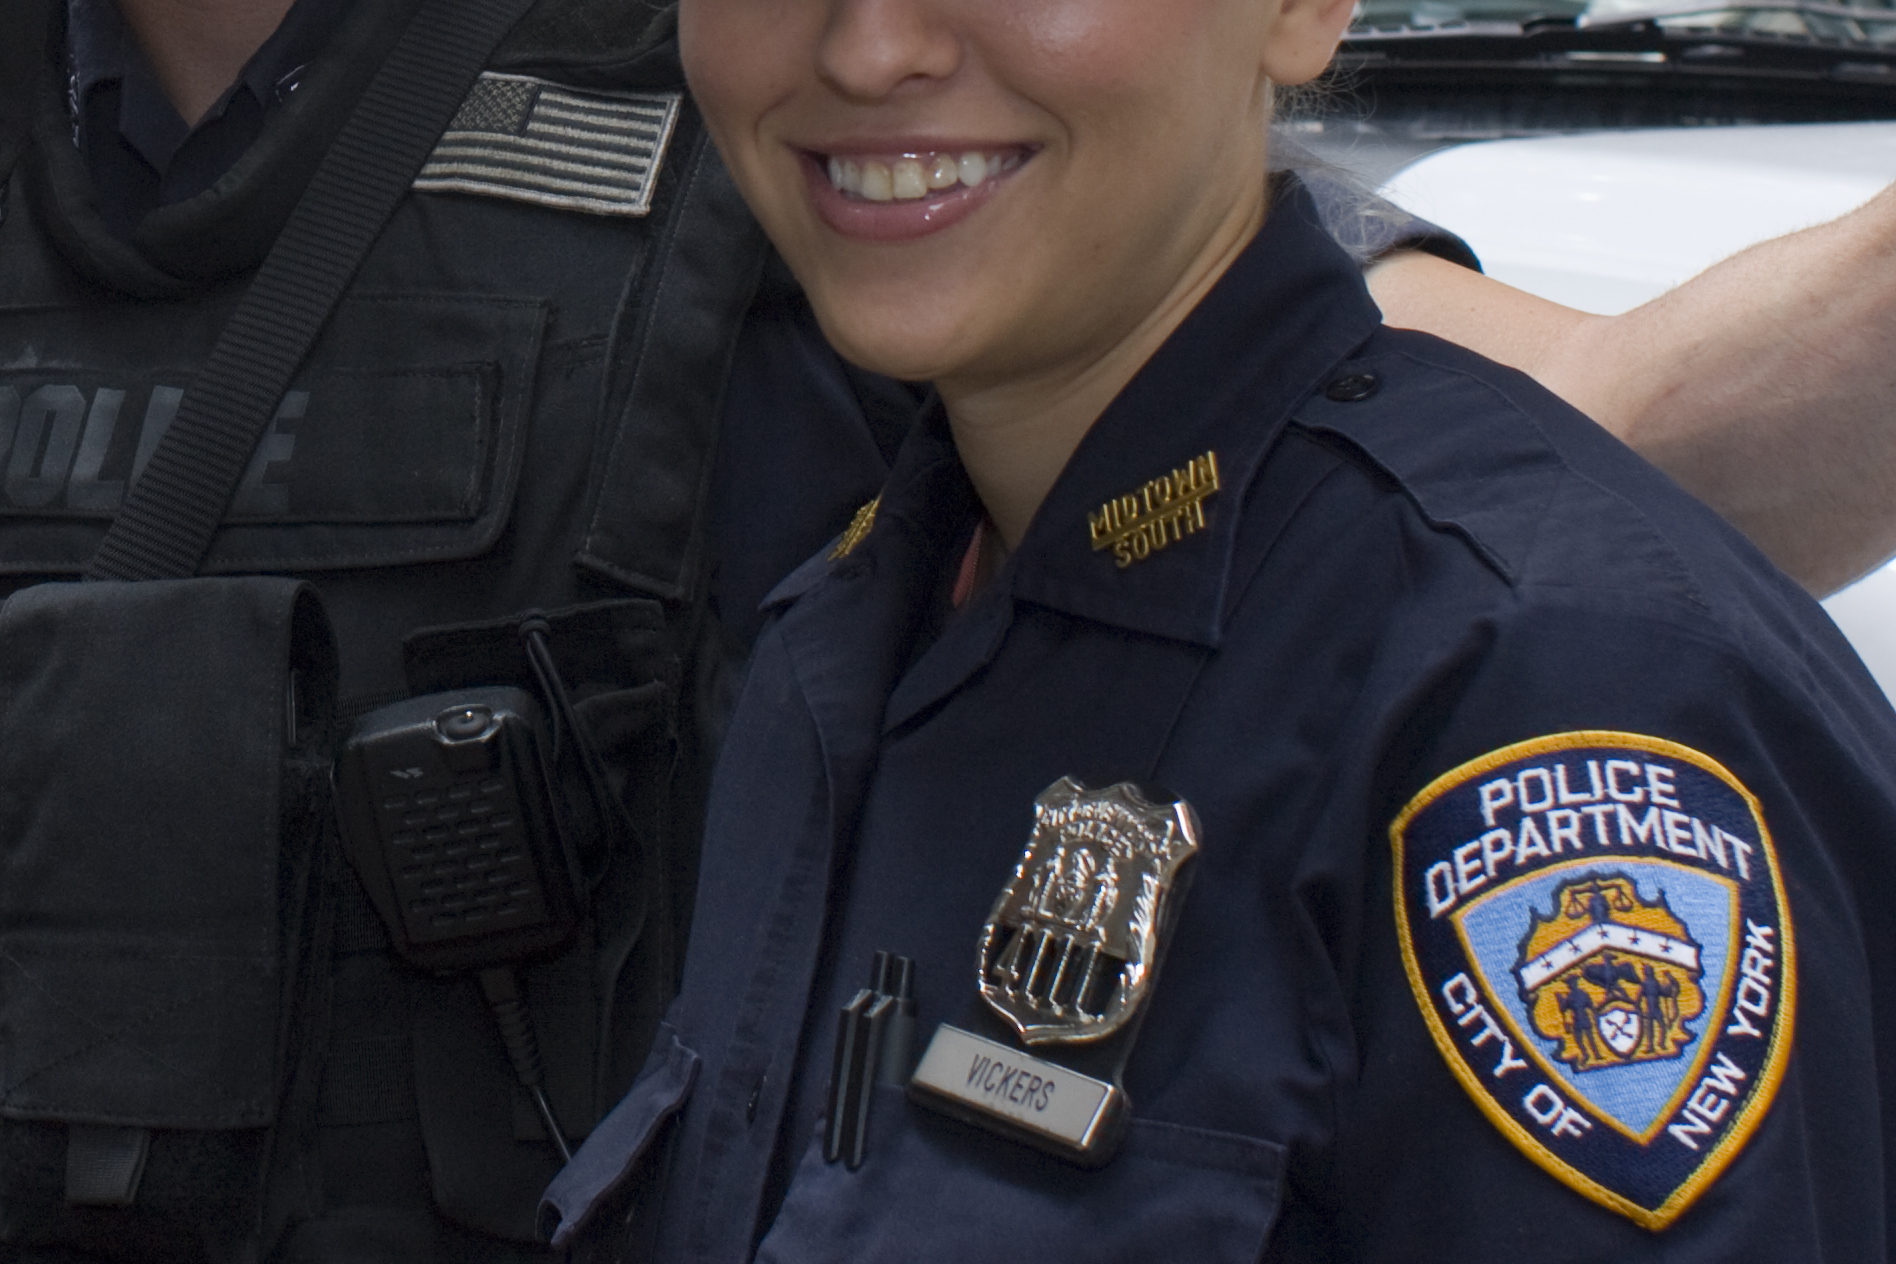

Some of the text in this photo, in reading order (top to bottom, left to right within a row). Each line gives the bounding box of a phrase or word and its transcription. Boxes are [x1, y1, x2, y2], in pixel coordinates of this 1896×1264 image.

[1088, 450, 1219, 540] MIDTOWN
[1114, 497, 1204, 568] SOUTH
[1479, 759, 1681, 827] POLICE
[1425, 803, 1752, 918] DEPARTMENT
[1442, 972, 1593, 1137] CITY OF
[1668, 919, 1775, 1150] NEW YORK
[967, 1053, 1055, 1112] VICKERS
